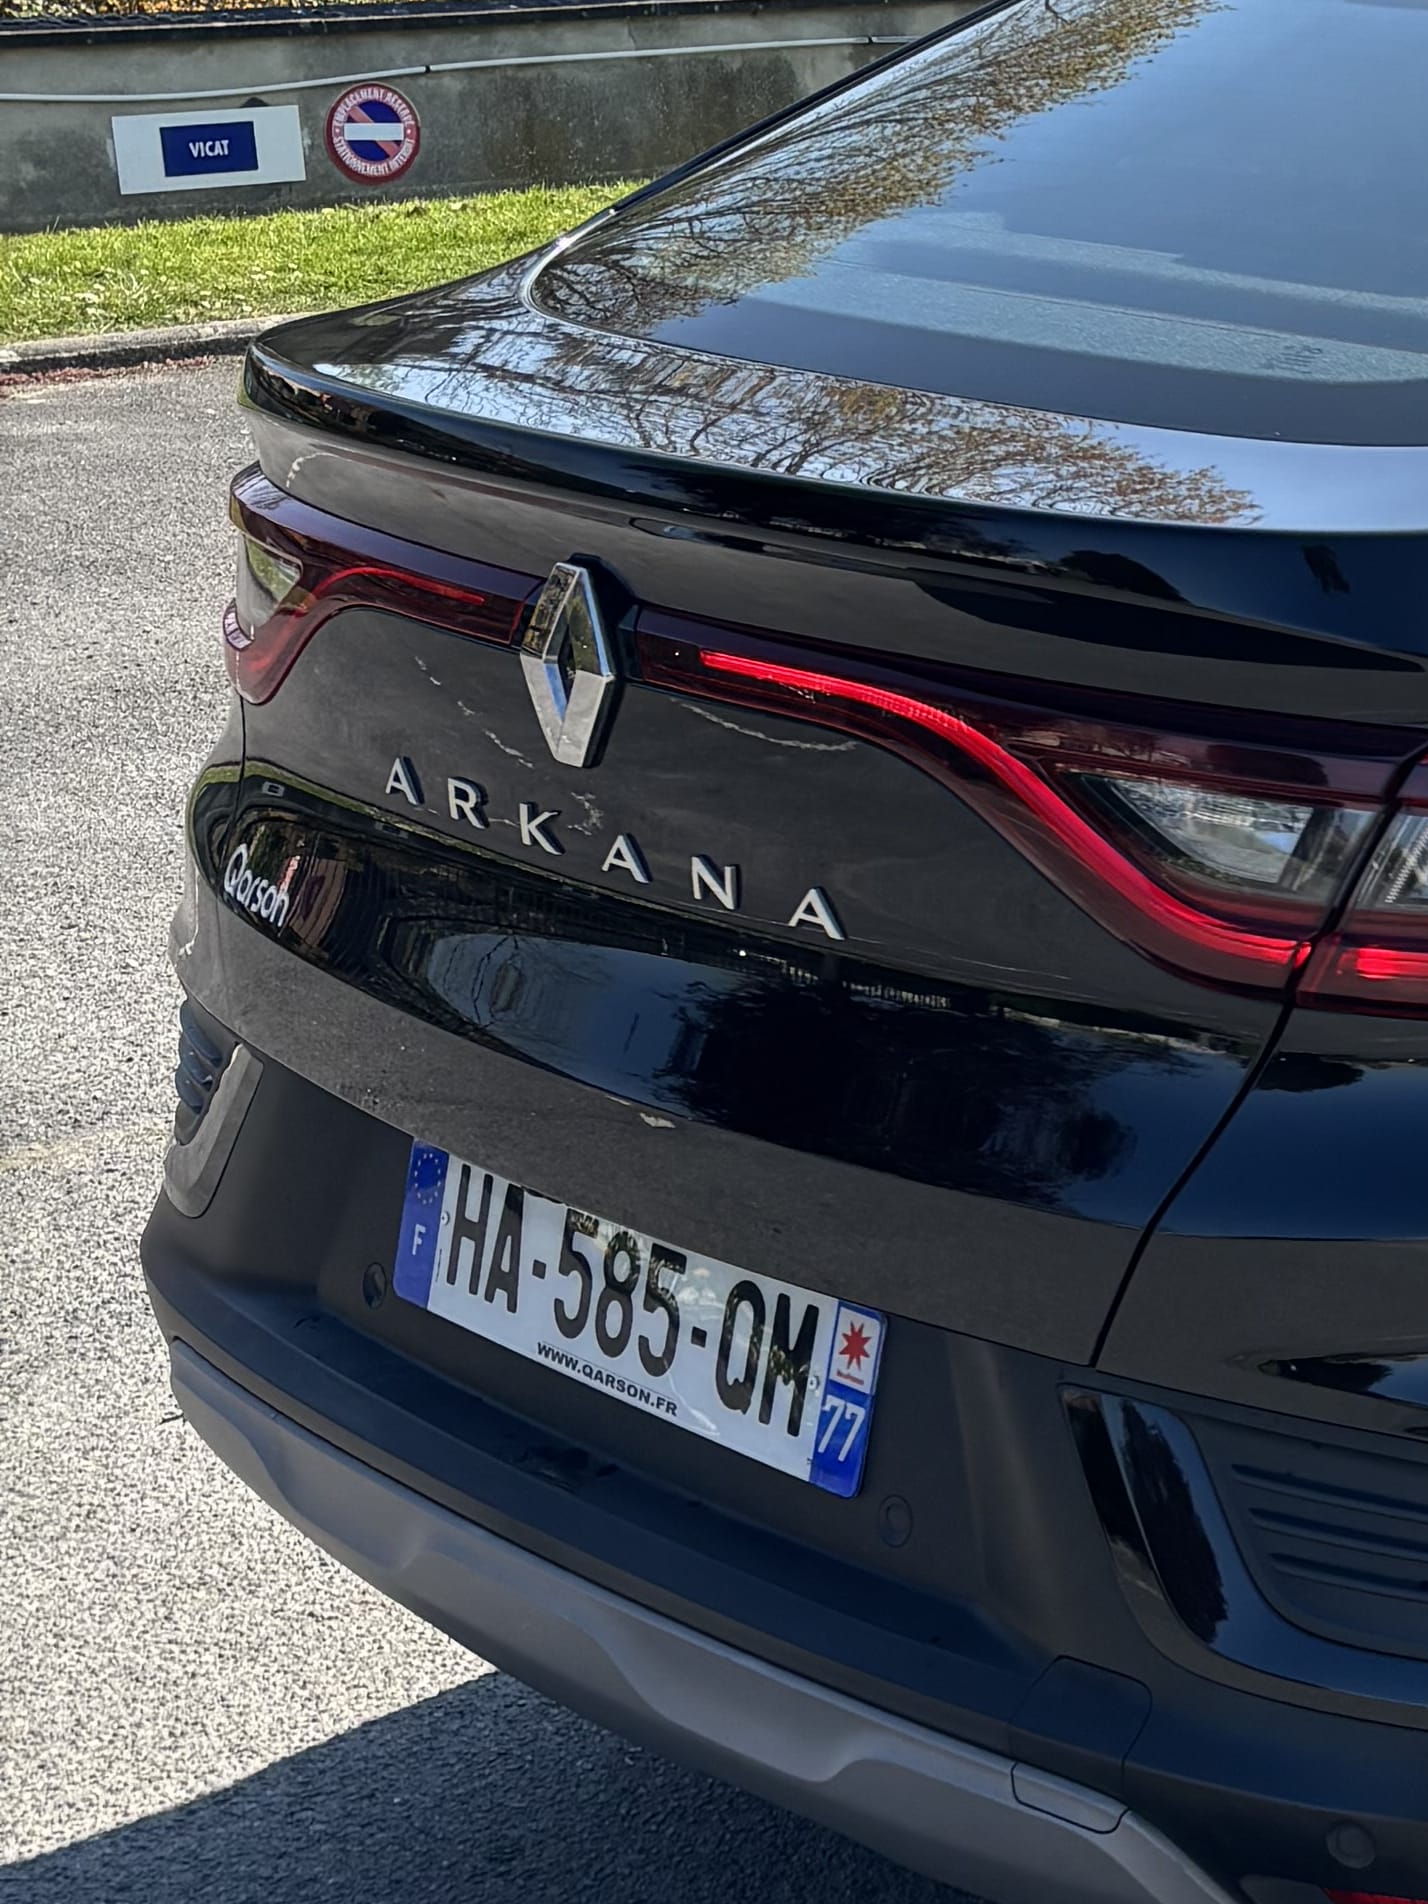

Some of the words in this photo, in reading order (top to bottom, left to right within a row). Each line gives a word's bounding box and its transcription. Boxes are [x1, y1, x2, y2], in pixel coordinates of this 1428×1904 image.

[188, 139, 229, 158] VICAT
[223, 842, 290, 928] Qarson
[384, 757, 846, 941] ARKANA
[410, 1223, 427, 1257] F
[446, 1163, 820, 1438] HA-585-QM
[536, 1341, 679, 1419] WWW.QARSON.FR
[820, 1394, 867, 1463] 77
